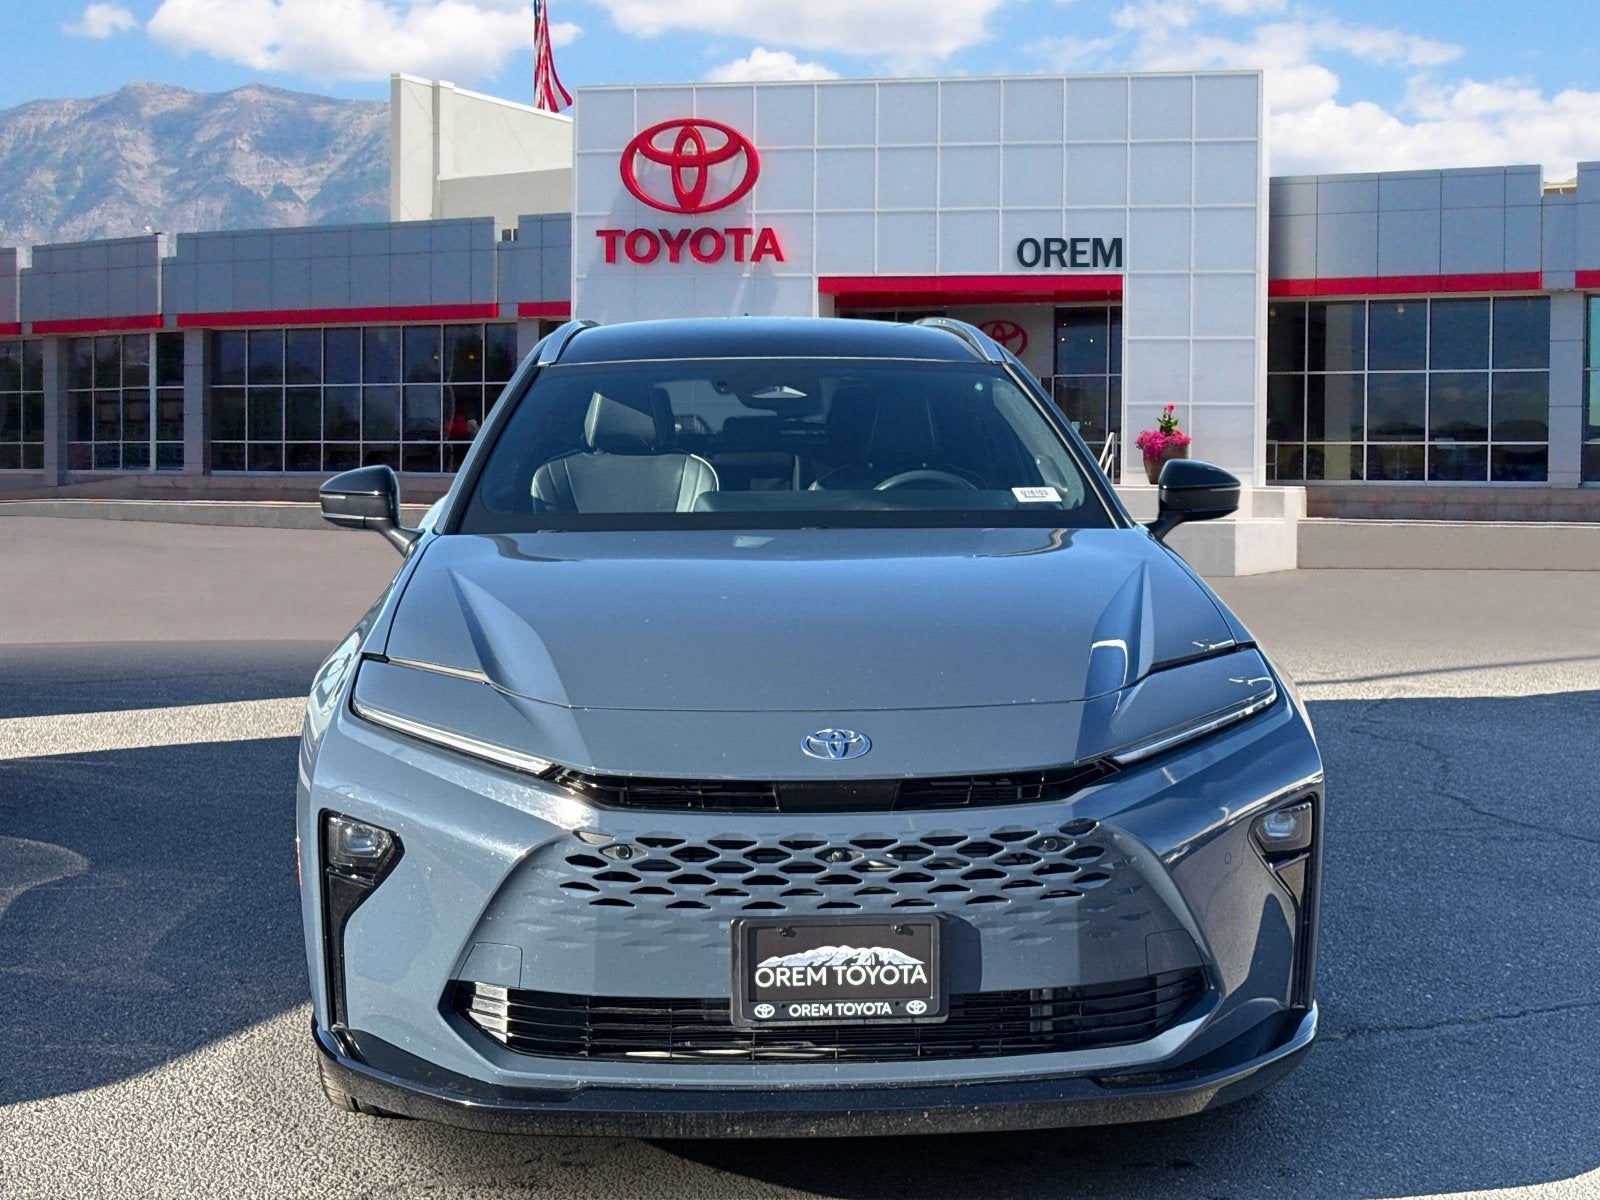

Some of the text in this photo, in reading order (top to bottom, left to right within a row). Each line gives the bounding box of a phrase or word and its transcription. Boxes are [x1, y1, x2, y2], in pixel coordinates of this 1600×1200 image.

[596, 227, 785, 264] TOYOTA
[1016, 237, 1123, 268] OREM
[755, 965, 928, 988] OREM TOYOTA
[788, 1002, 892, 1017] OREM TOYOTA
